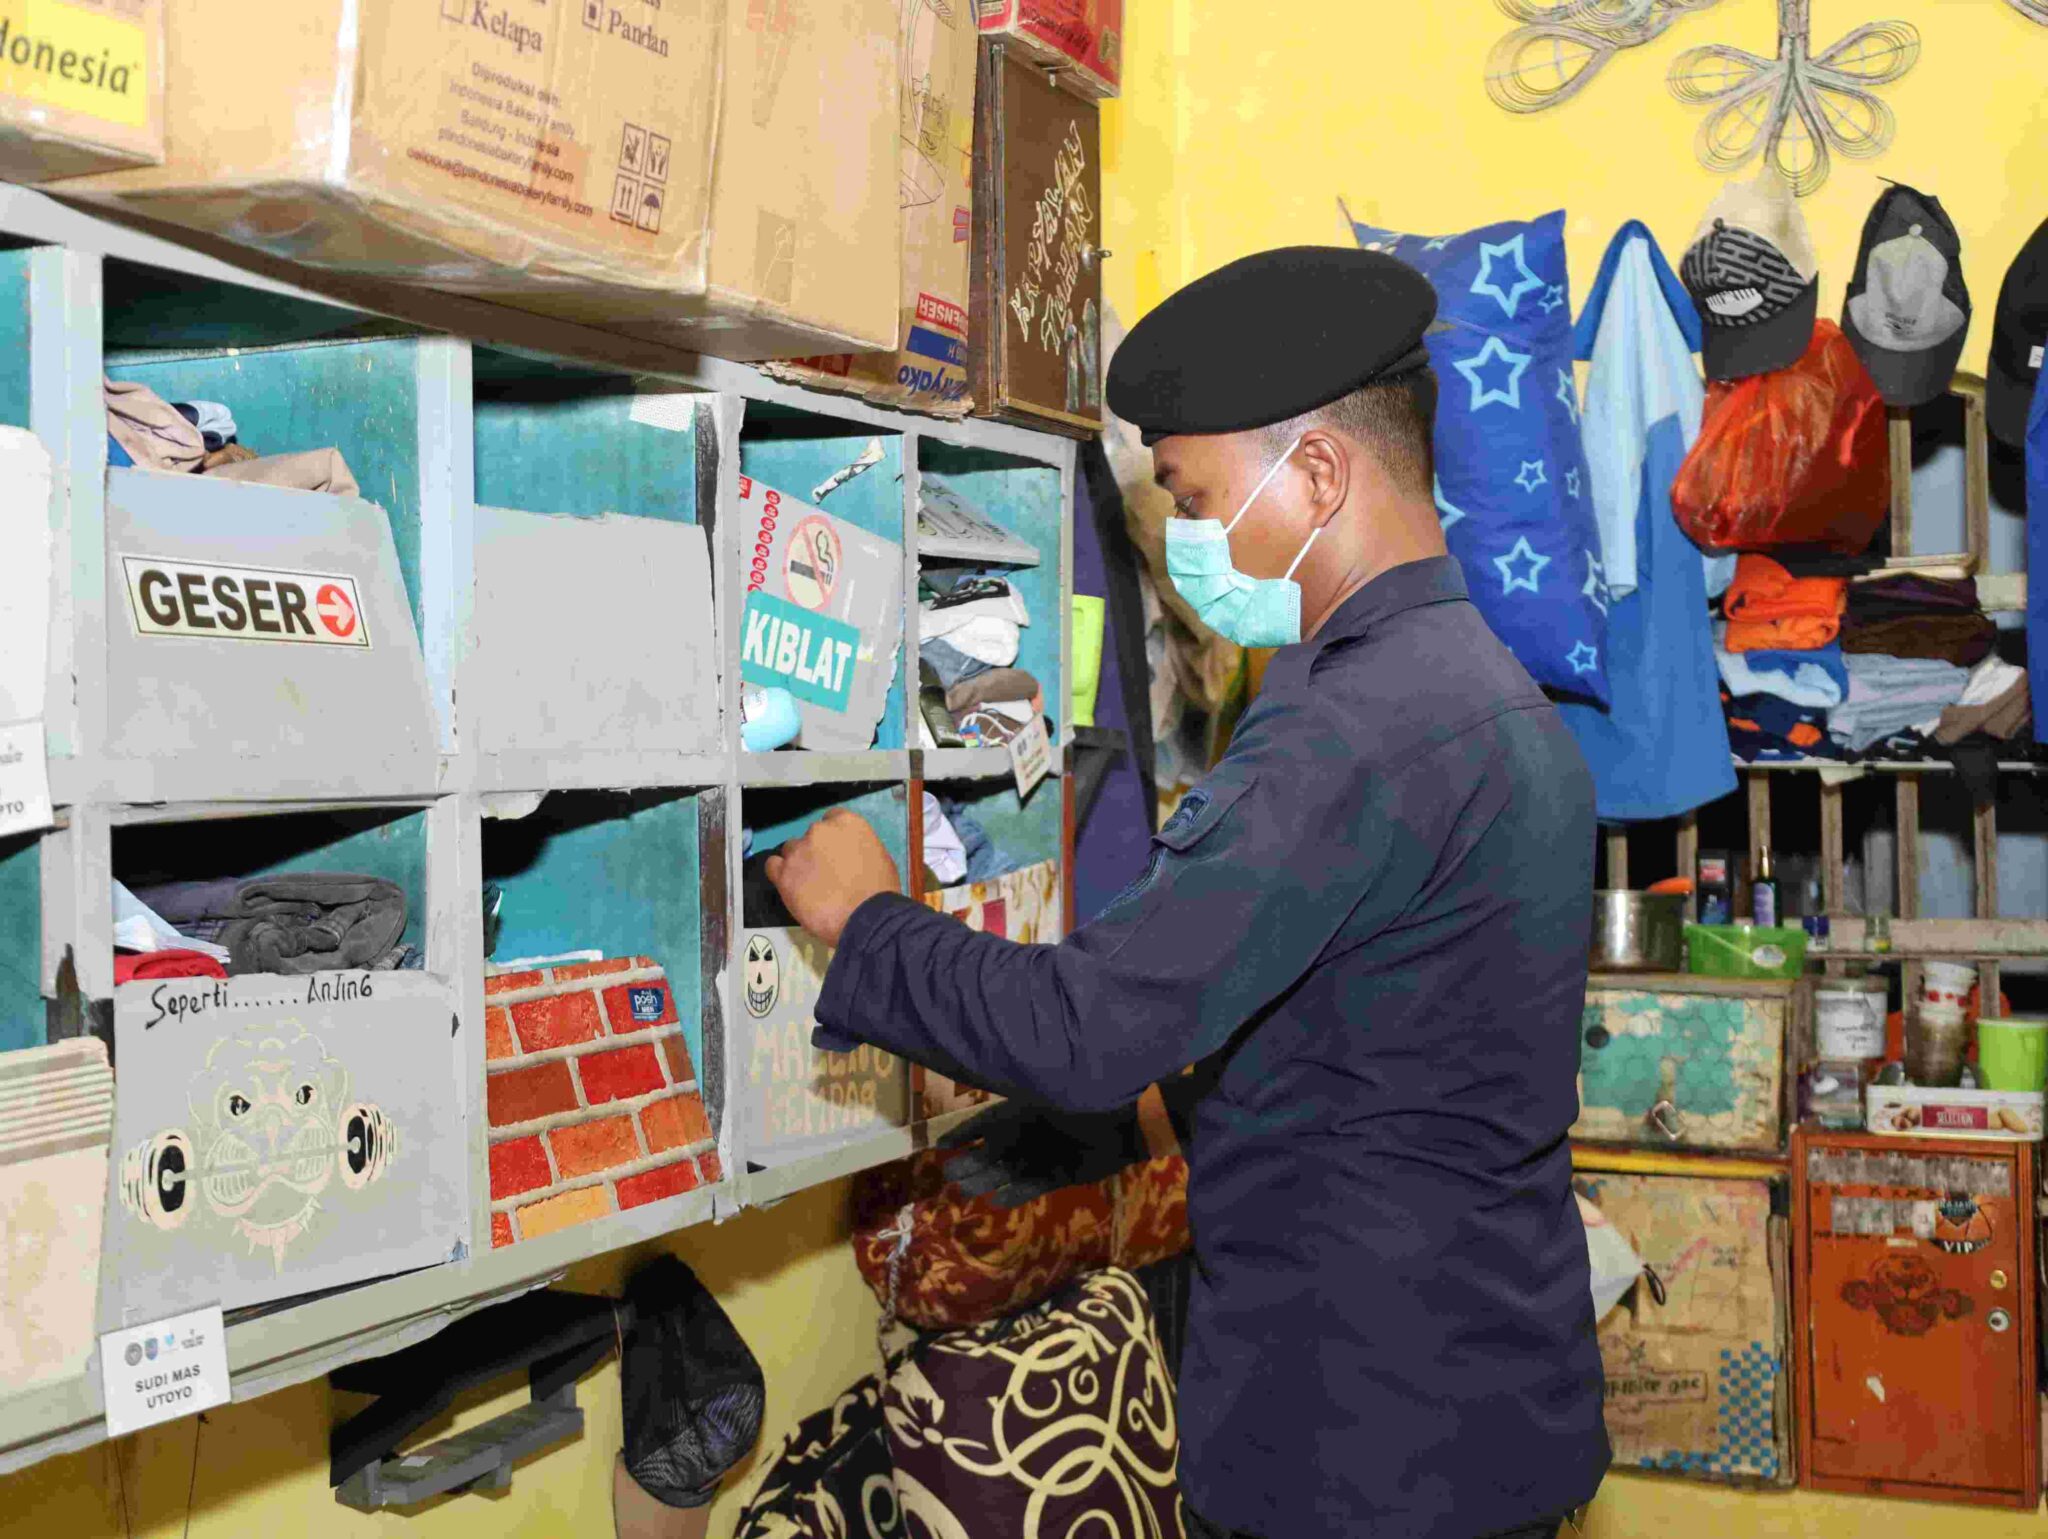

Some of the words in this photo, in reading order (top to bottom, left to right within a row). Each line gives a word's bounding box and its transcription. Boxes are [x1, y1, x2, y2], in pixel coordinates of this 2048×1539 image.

[470, 0, 544, 52] Kelapa
[608, 8, 669, 57] Pandan
[515, 131, 559, 157] Indonesia
[139, 569, 316, 635] GESER
[742, 609, 852, 693] KIBLAT
[1943, 1239, 1974, 1255] VIP
[135, 1373, 168, 1393] SUDI
[171, 1365, 201, 1382] MAS
[147, 1386, 193, 1408] UTOYO
